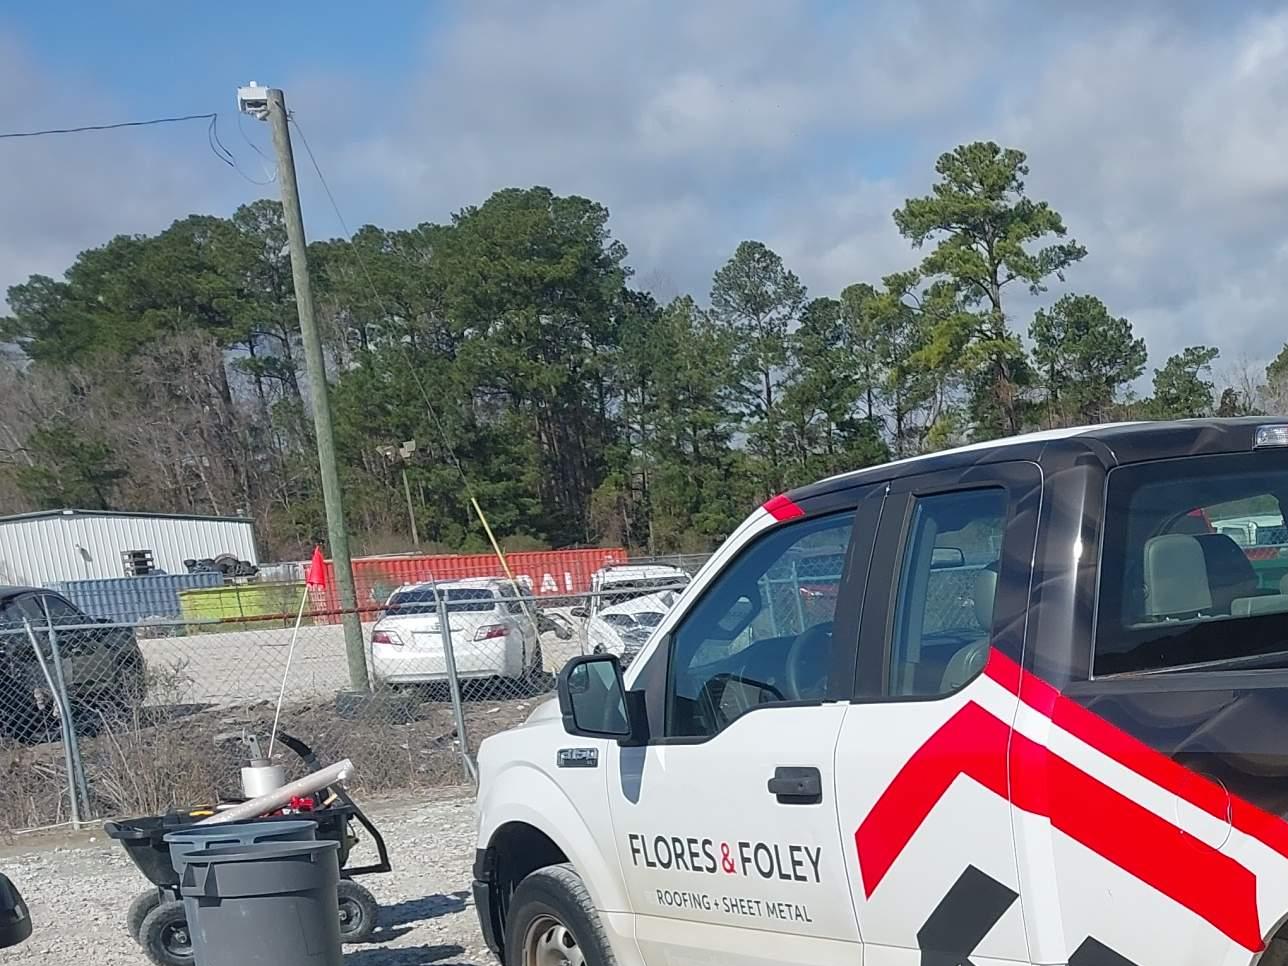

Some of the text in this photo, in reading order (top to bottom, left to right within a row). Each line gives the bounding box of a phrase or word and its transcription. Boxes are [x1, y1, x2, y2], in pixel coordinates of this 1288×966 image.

[656, 889, 813, 923] ROOFING + SHEET METAL
